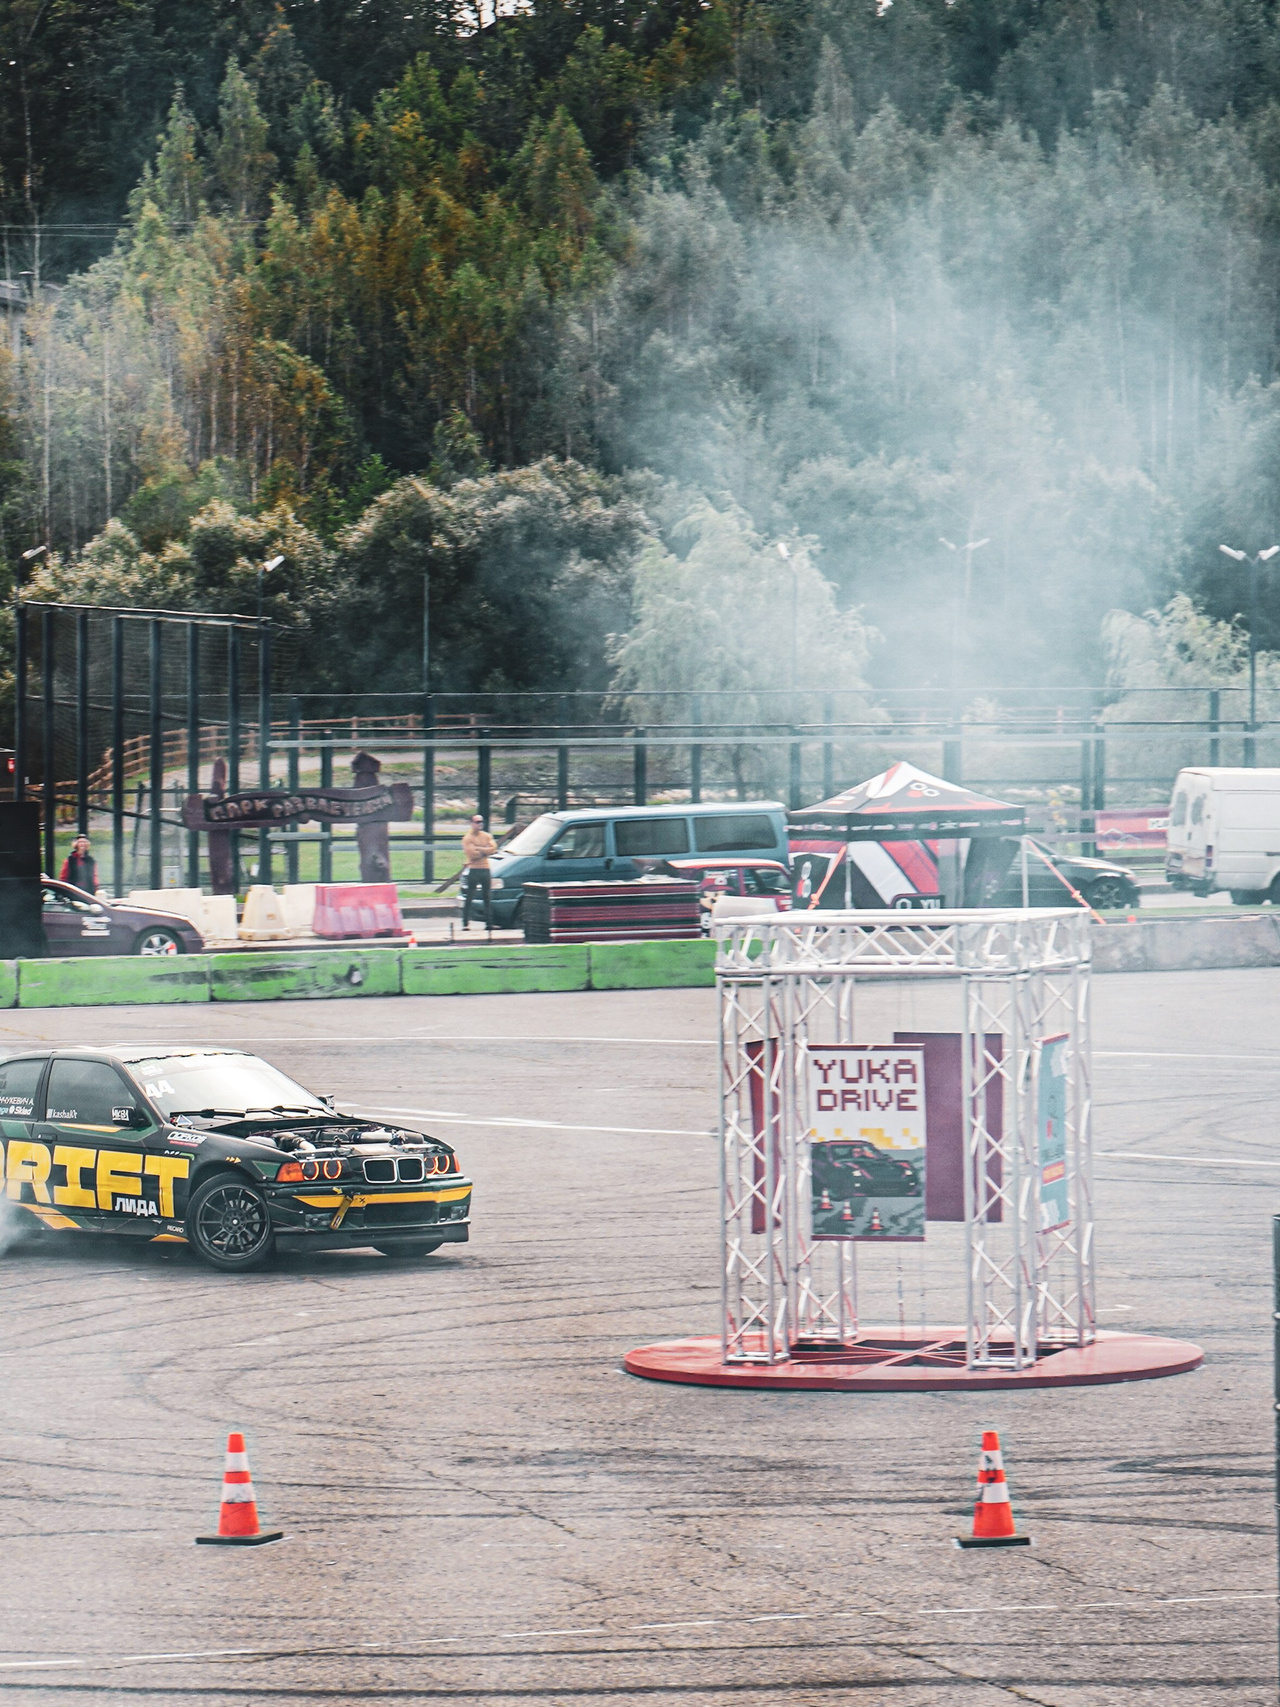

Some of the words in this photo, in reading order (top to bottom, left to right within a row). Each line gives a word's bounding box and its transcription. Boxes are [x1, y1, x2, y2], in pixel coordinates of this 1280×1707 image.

[813, 1058, 918, 1084] YUKA
[145, 1080, 175, 1098] 44
[817, 1089, 918, 1112] DRIVE
[115, 1197, 158, 1216] ЛИДА
